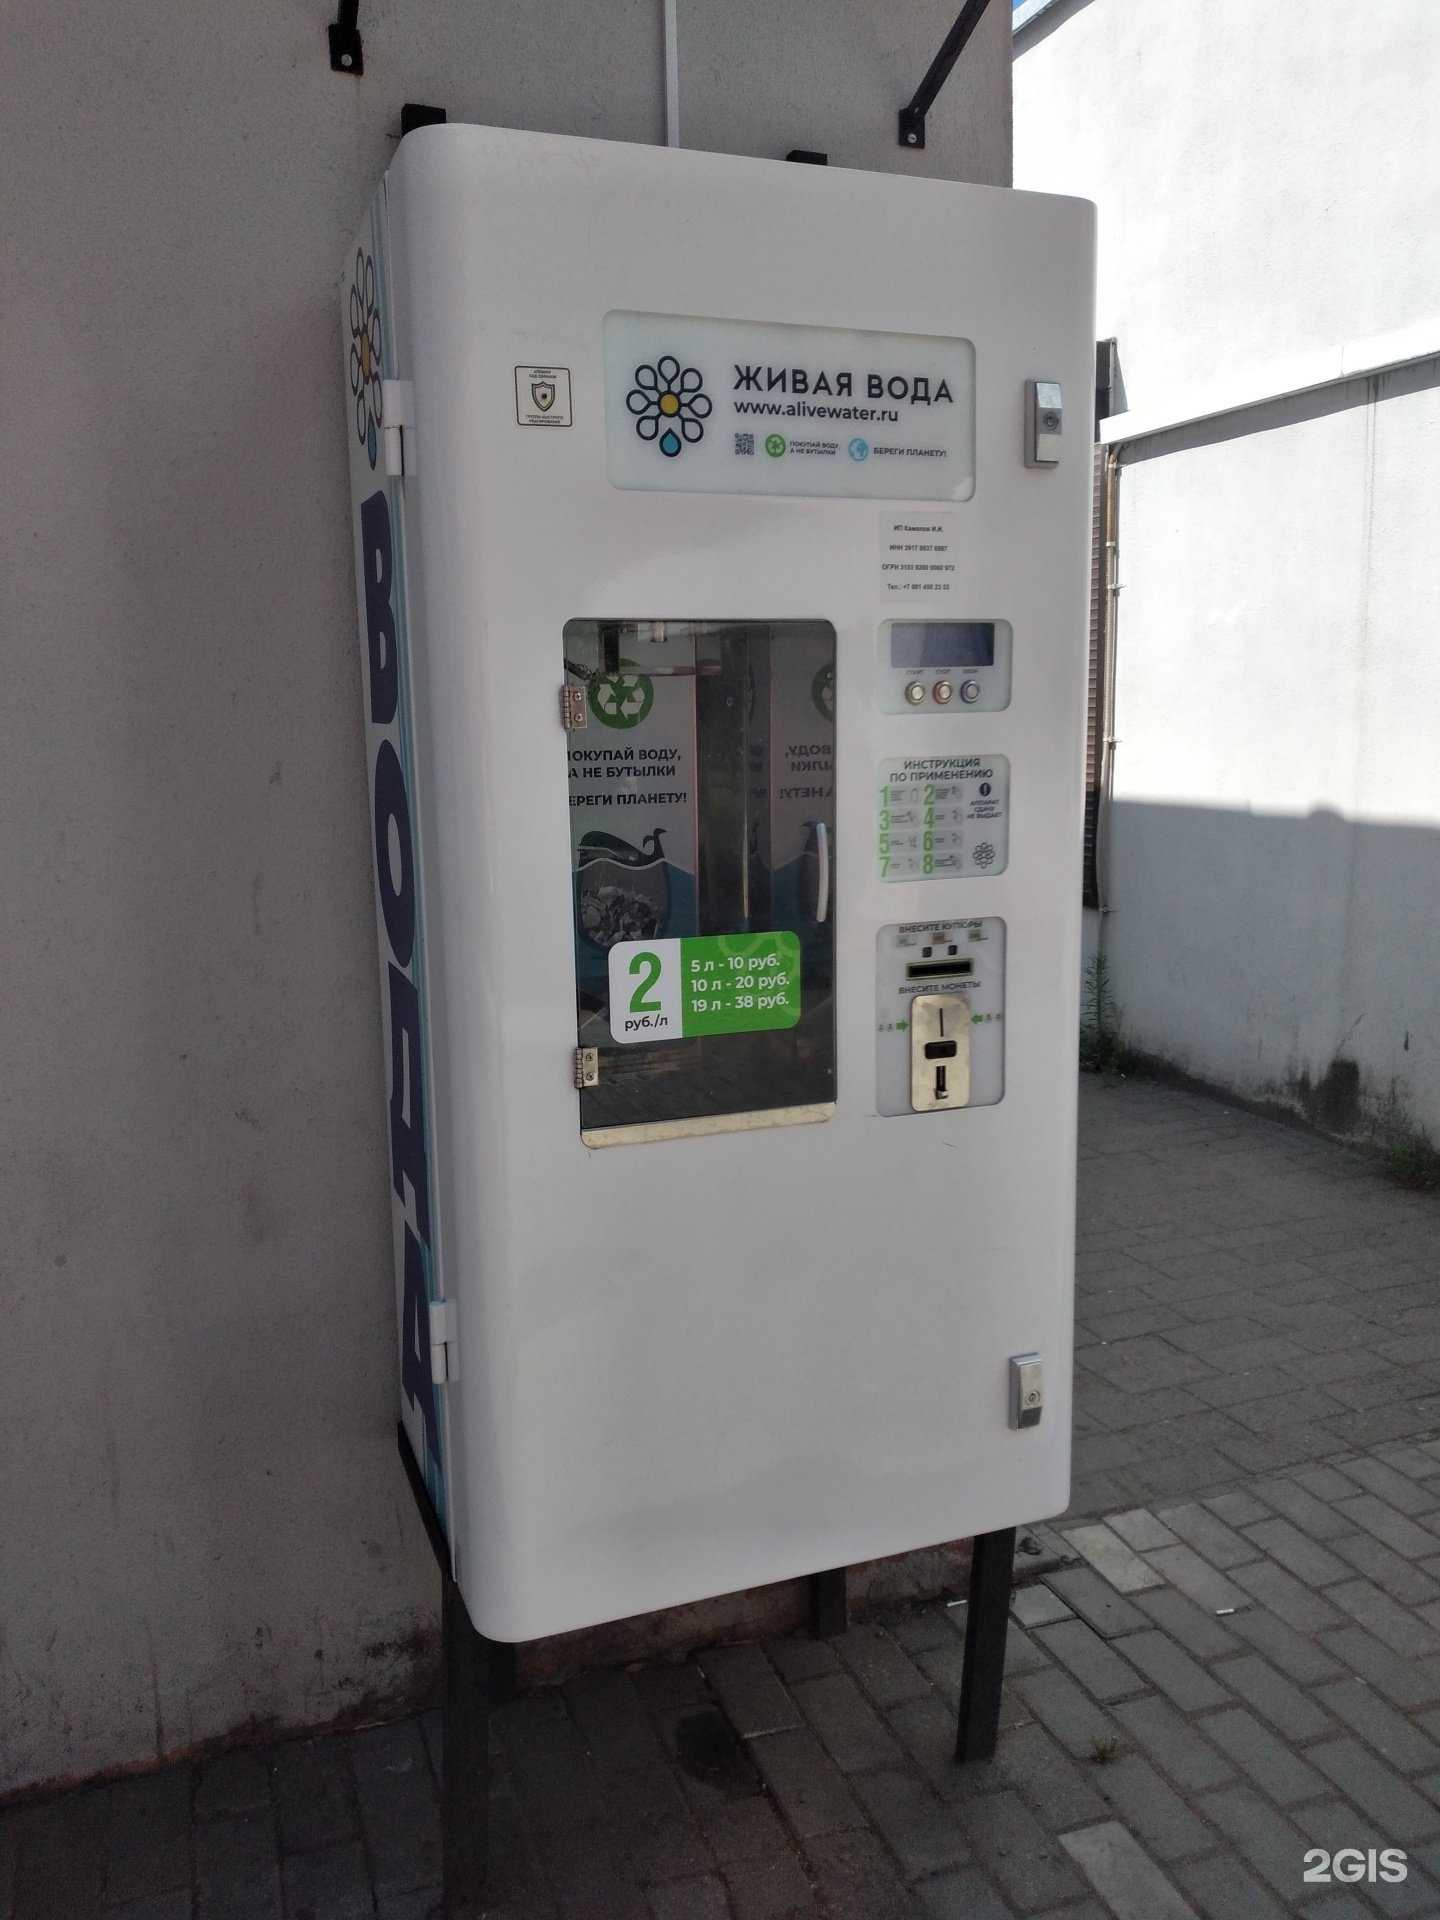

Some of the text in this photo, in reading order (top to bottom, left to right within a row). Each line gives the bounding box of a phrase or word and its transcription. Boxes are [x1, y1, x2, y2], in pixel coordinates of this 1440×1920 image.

[734, 364, 954, 405] ЖИВАЯ ВОДА
[734, 401, 899, 422] www.alivewater.ru
[874, 447, 947, 458] БЕРЕГИ ПЛАНЕТУ!
[638, 748, 682, 763] ВОДУ,
[904, 758, 980, 770] ИНСТРУКЦИЯ
[568, 765, 676, 779] А НЕ БУТЫЛКИ
[890, 769, 993, 782] ПО ПРИМЕНЕНИЮ
[569, 792, 687, 807] ЕРЕГИ ПЛАНЕТУ!
[880, 785, 889, 807] 1
[924, 784, 935, 805] 2
[880, 810, 890, 831] 3
[923, 807, 934, 828] 4
[880, 833, 890, 854] 5
[923, 831, 933, 851] 6
[880, 856, 890, 878] 7
[923, 854, 933, 874] 8
[899, 922, 940, 934] ВНЕСИТЕ
[691, 960, 701, 973] 5
[705, 962, 714, 972] л
[728, 956, 744, 970] 10
[748, 953, 781, 970] руб.
[628, 951, 662, 1014] 2
[691, 979, 708, 993] 10
[711, 981, 721, 992] л
[735, 976, 754, 989] 20
[758, 973, 790, 990] руб.
[899, 981, 981, 994] ВНЕСИТЕ МОНЕТЫ
[691, 999, 708, 1013] 19
[711, 1000, 721, 1012] л
[735, 996, 754, 1009] 38
[758, 992, 790, 1009] руб.
[624, 1014, 668, 1031] руб./л
